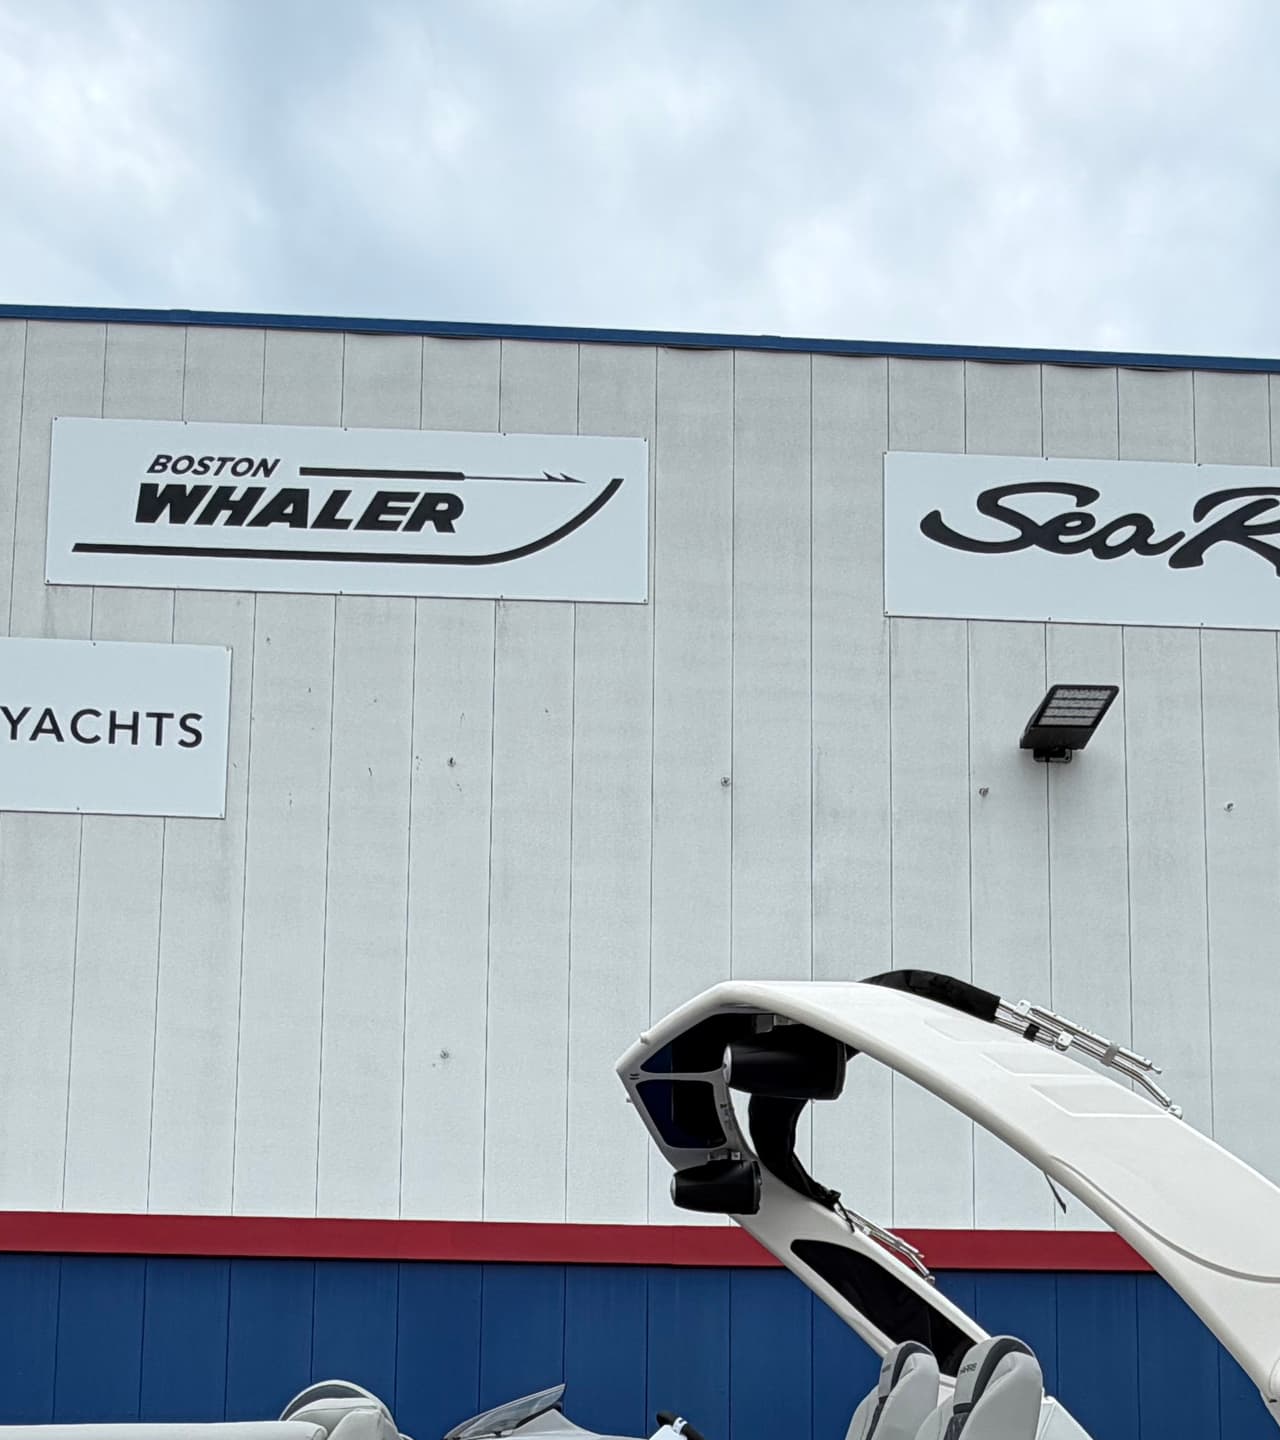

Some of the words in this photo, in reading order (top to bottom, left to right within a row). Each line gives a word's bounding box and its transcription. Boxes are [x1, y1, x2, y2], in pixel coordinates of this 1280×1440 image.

[146, 454, 281, 478] BOSTON
[135, 482, 464, 534] WHALER
[919, 481, 1186, 560] Sea
[0, 706, 202, 748] YACHTS
